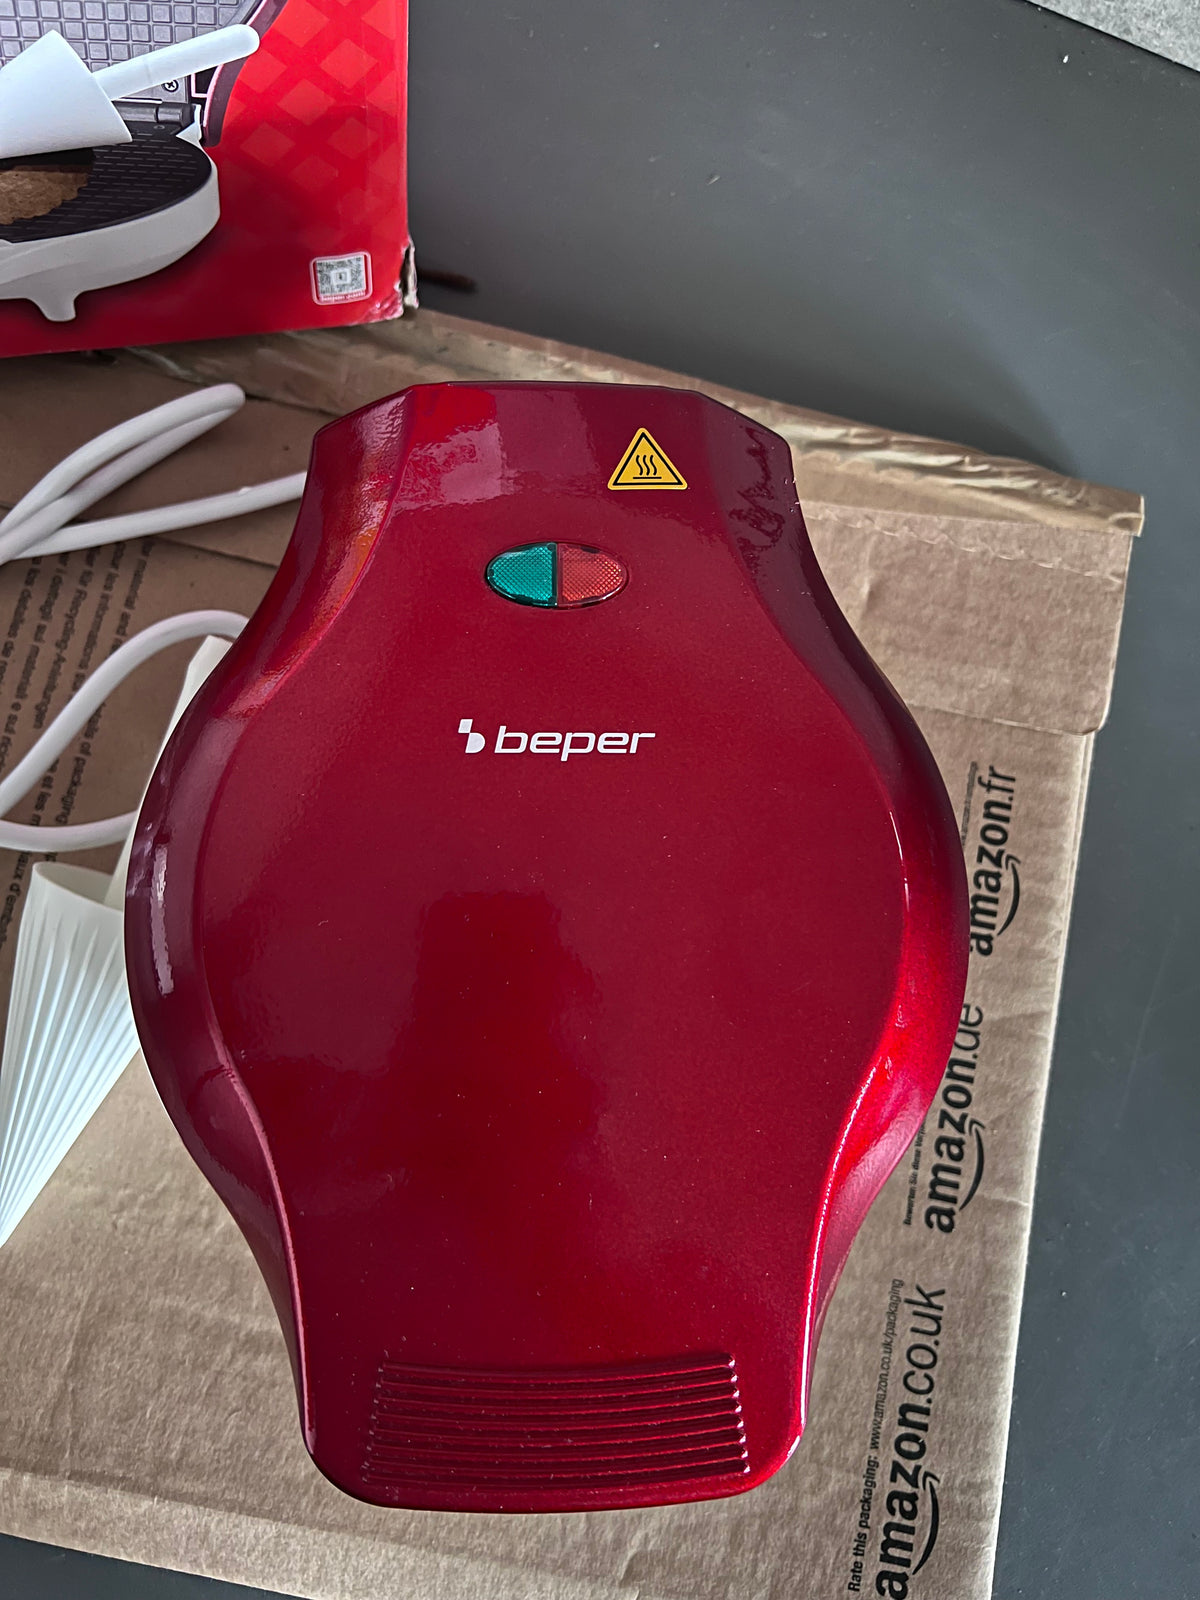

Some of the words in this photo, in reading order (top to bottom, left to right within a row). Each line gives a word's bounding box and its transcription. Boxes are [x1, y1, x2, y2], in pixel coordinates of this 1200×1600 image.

[116, 611, 131, 636] and
[79, 741, 91, 757] of
[494, 725, 656, 762] beper
[33, 791, 50, 812] les
[55, 756, 86, 826] packaging
[969, 765, 1016, 957] amazon.fr
[924, 1003, 983, 1234] amazon.de
[870, 1278, 905, 1450] www.amazon.co.uk/packaging
[876, 1284, 946, 1600] amazon.co.uk
[859, 1455, 880, 1530] packaging:
[852, 1532, 867, 1557] this
[847, 1561, 863, 1592] Rate
